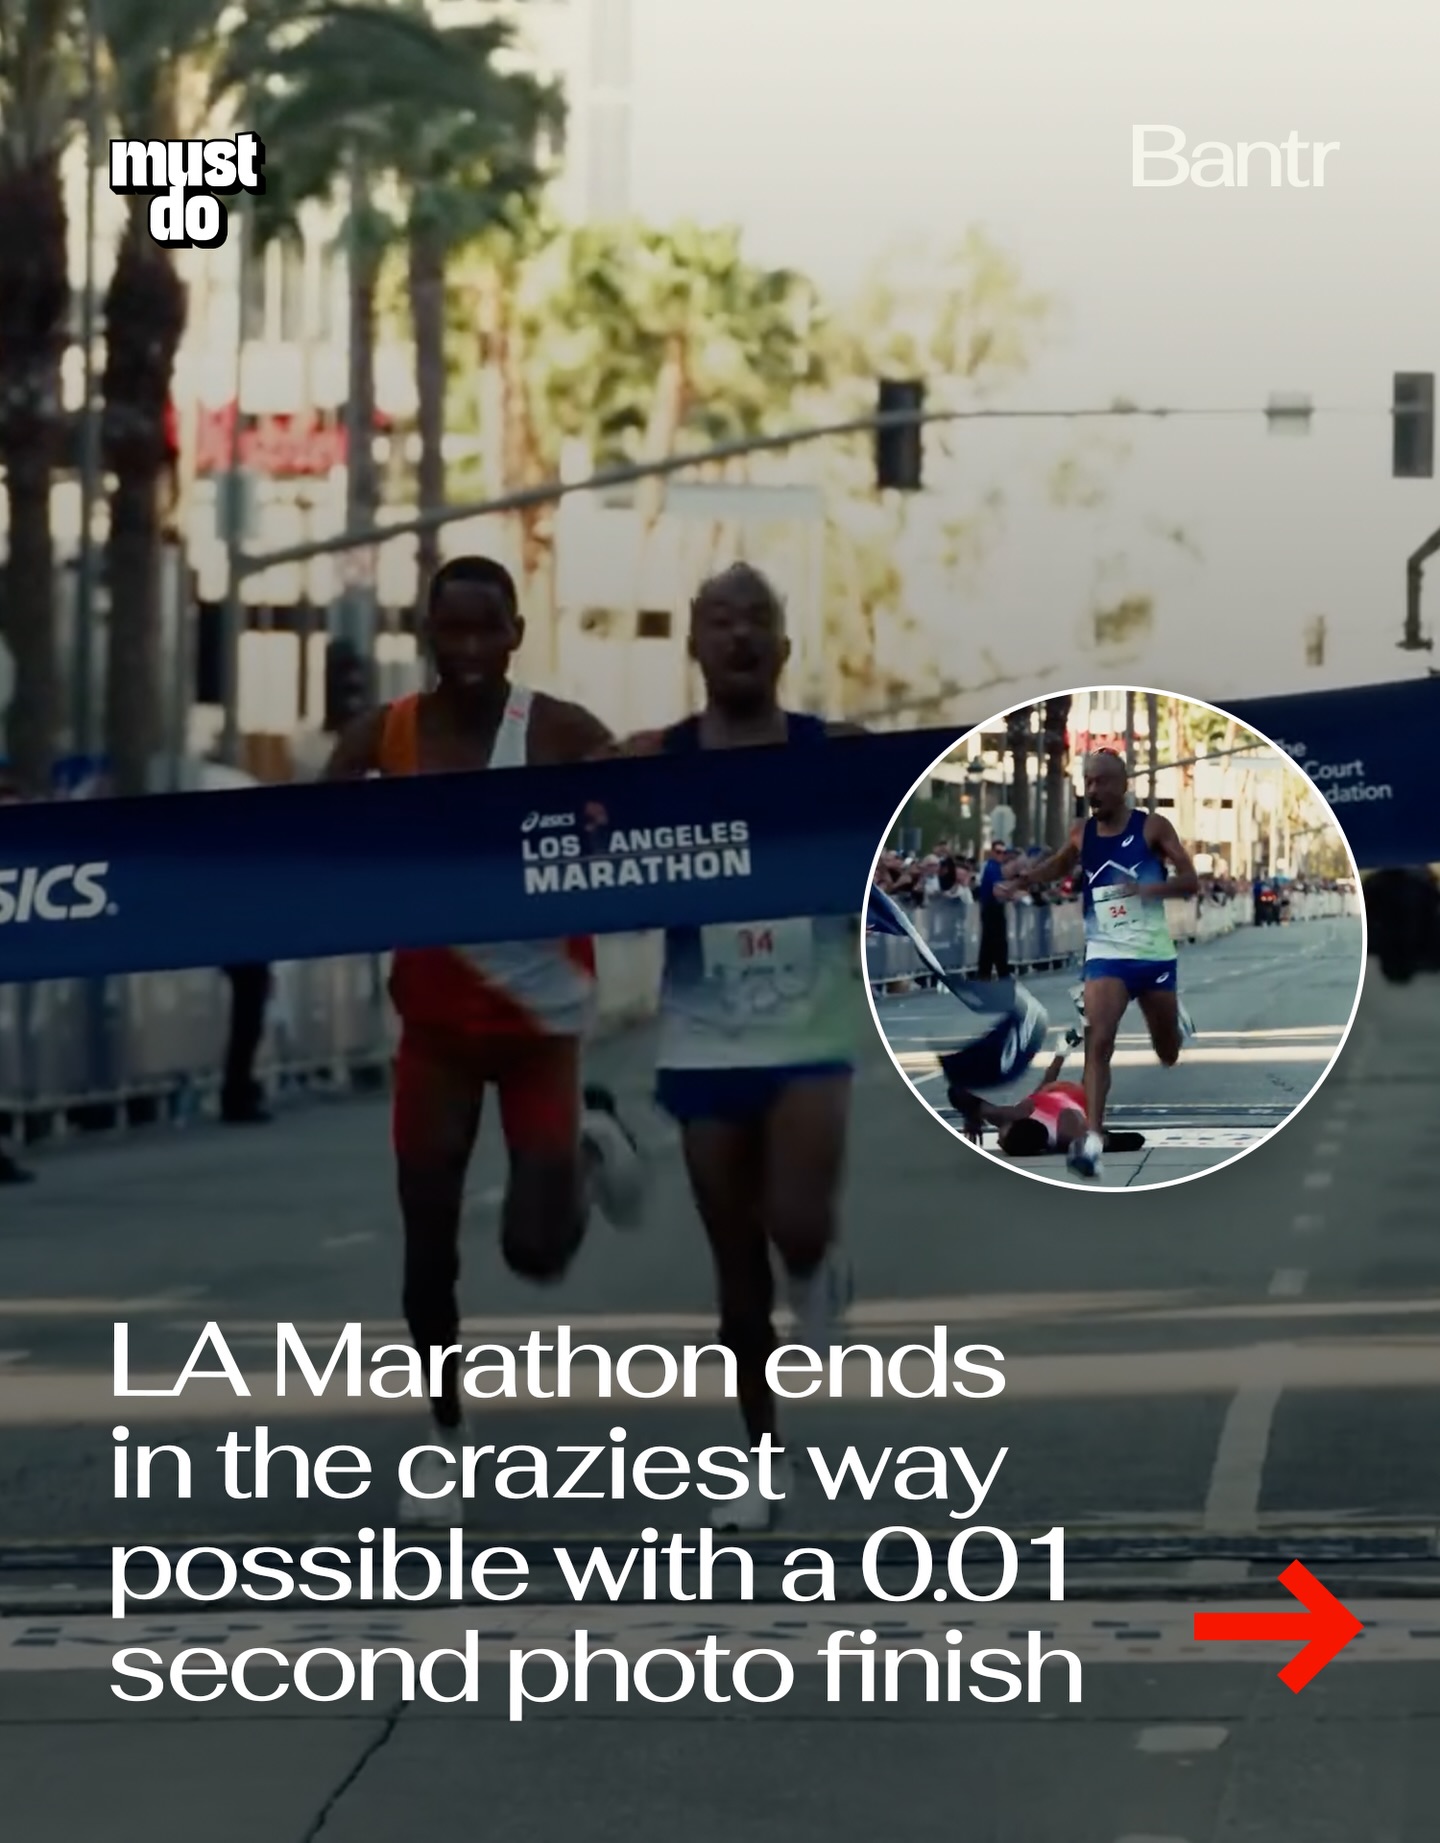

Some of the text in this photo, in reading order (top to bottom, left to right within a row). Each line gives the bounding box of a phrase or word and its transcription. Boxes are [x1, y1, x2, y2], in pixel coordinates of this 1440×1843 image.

[1273, 739, 1307, 758] he
[1303, 760, 1365, 781] Court
[1321, 781, 1393, 804] dation
[521, 819, 749, 862] LOS ANGELES
[523, 848, 752, 895] MARATHON
[1108, 904, 1128, 919] 34
